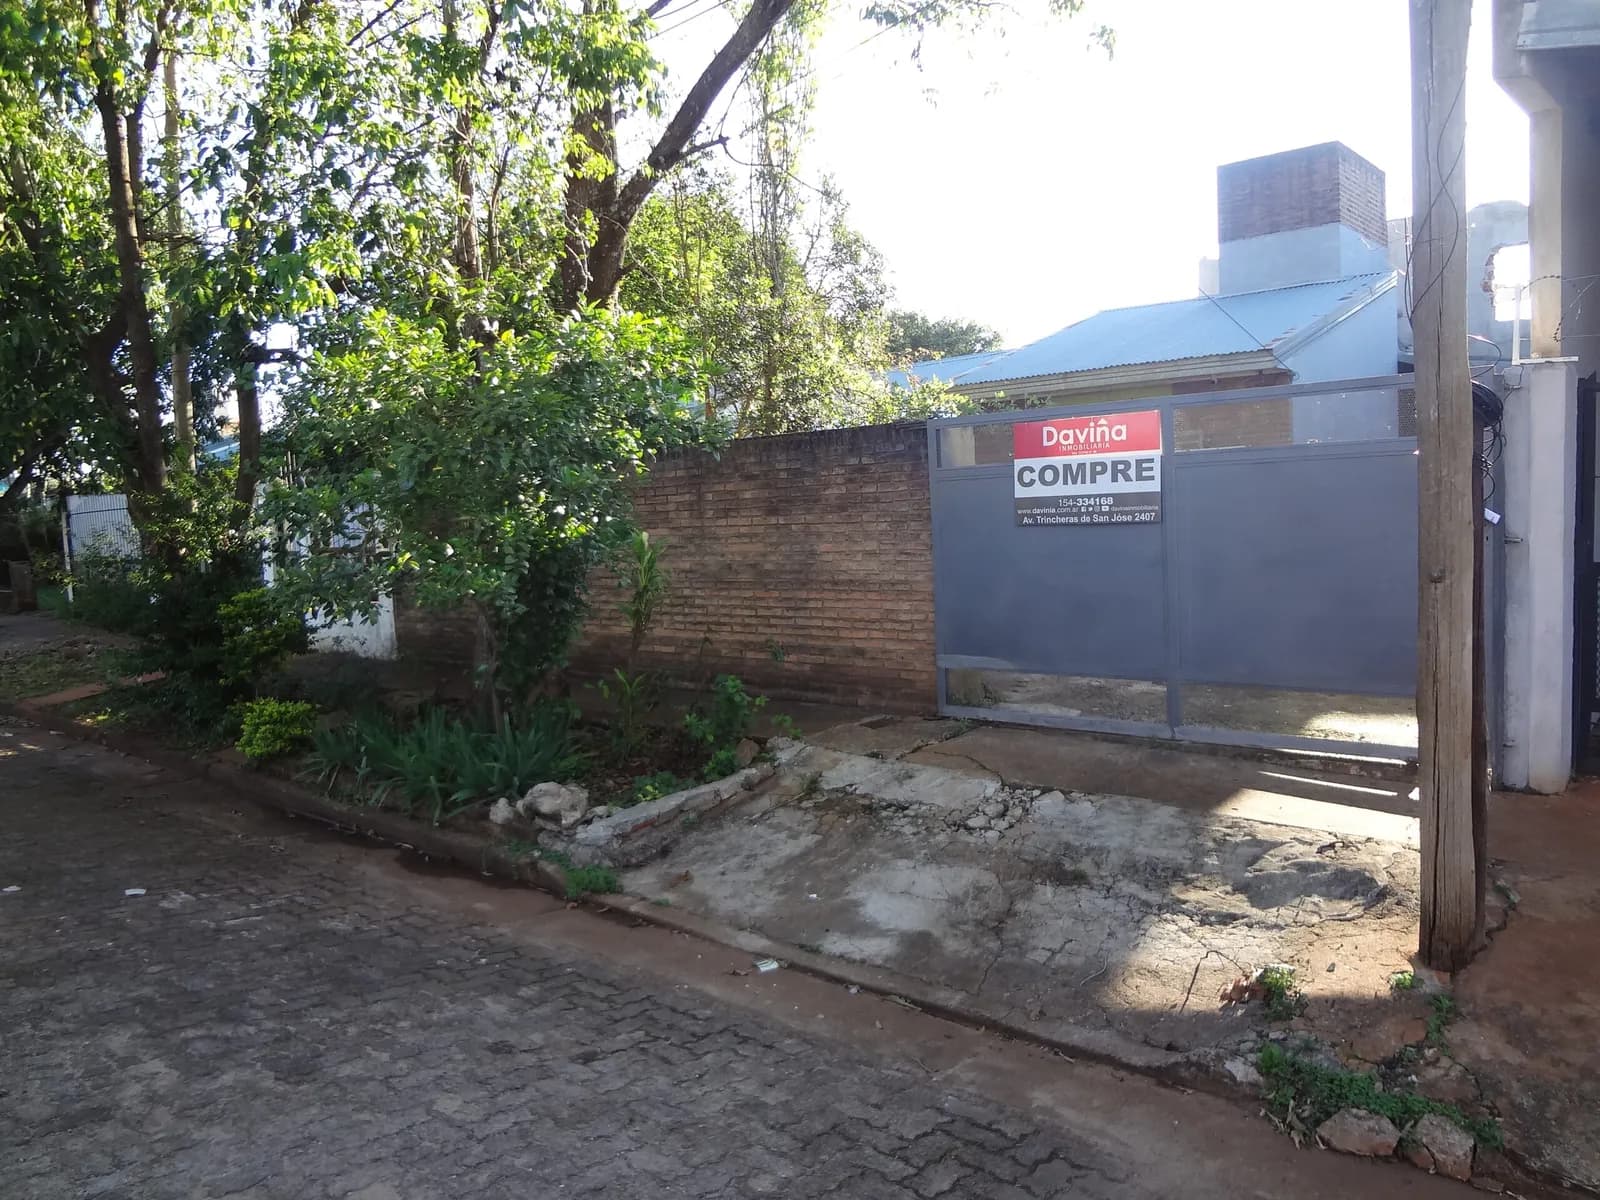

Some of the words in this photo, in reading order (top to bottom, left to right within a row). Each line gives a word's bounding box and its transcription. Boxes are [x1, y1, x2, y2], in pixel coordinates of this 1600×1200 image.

[1058, 441, 1110, 452] INMOBILIARIA
[1017, 458, 1155, 488] COMPRE
[1058, 496, 1114, 507] 154-334168
[1022, 516, 1035, 525] Av.
[1036, 514, 1079, 525] Trincheras
[1080, 513, 1091, 523] de
[1092, 513, 1110, 522] San
[1134, 511, 1156, 521] 2407
